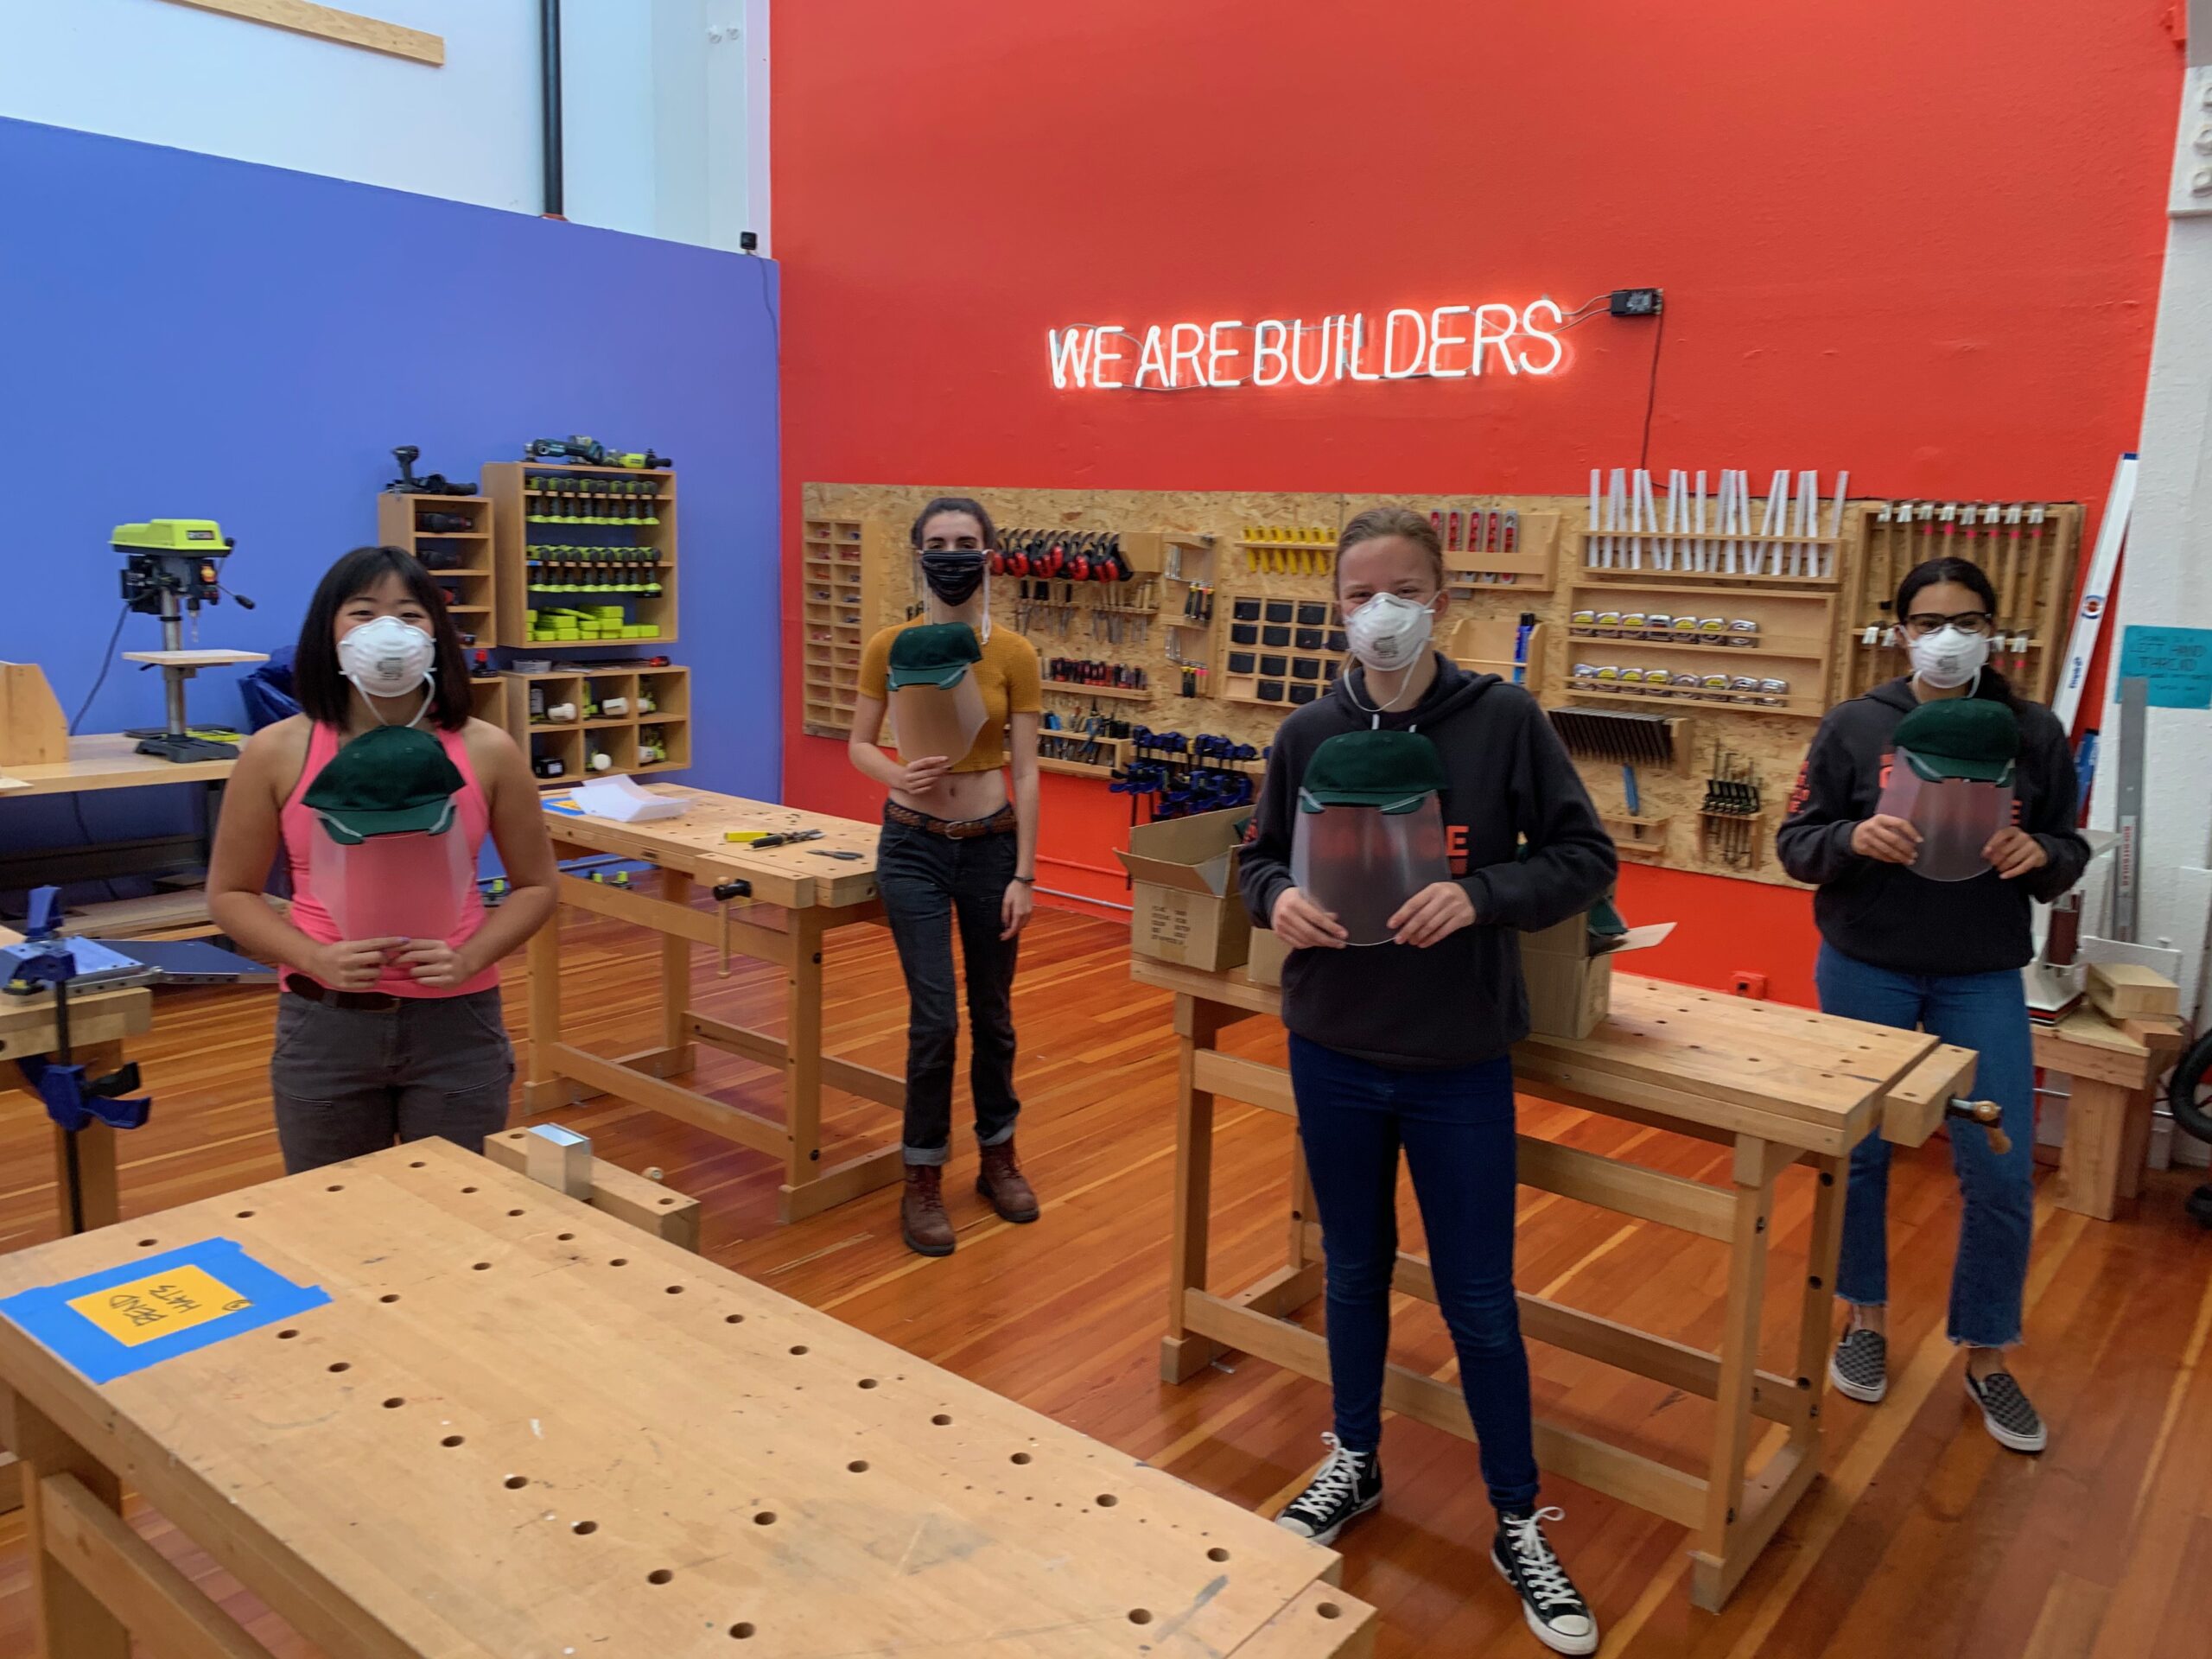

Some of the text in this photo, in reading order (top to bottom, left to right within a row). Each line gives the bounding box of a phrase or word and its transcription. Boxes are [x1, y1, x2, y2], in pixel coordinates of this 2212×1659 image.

[1048, 299, 1562, 389] WE ARE BUILDERS
[110, 1294, 168, 1327] BEND
[149, 1285, 203, 1314] HATS
